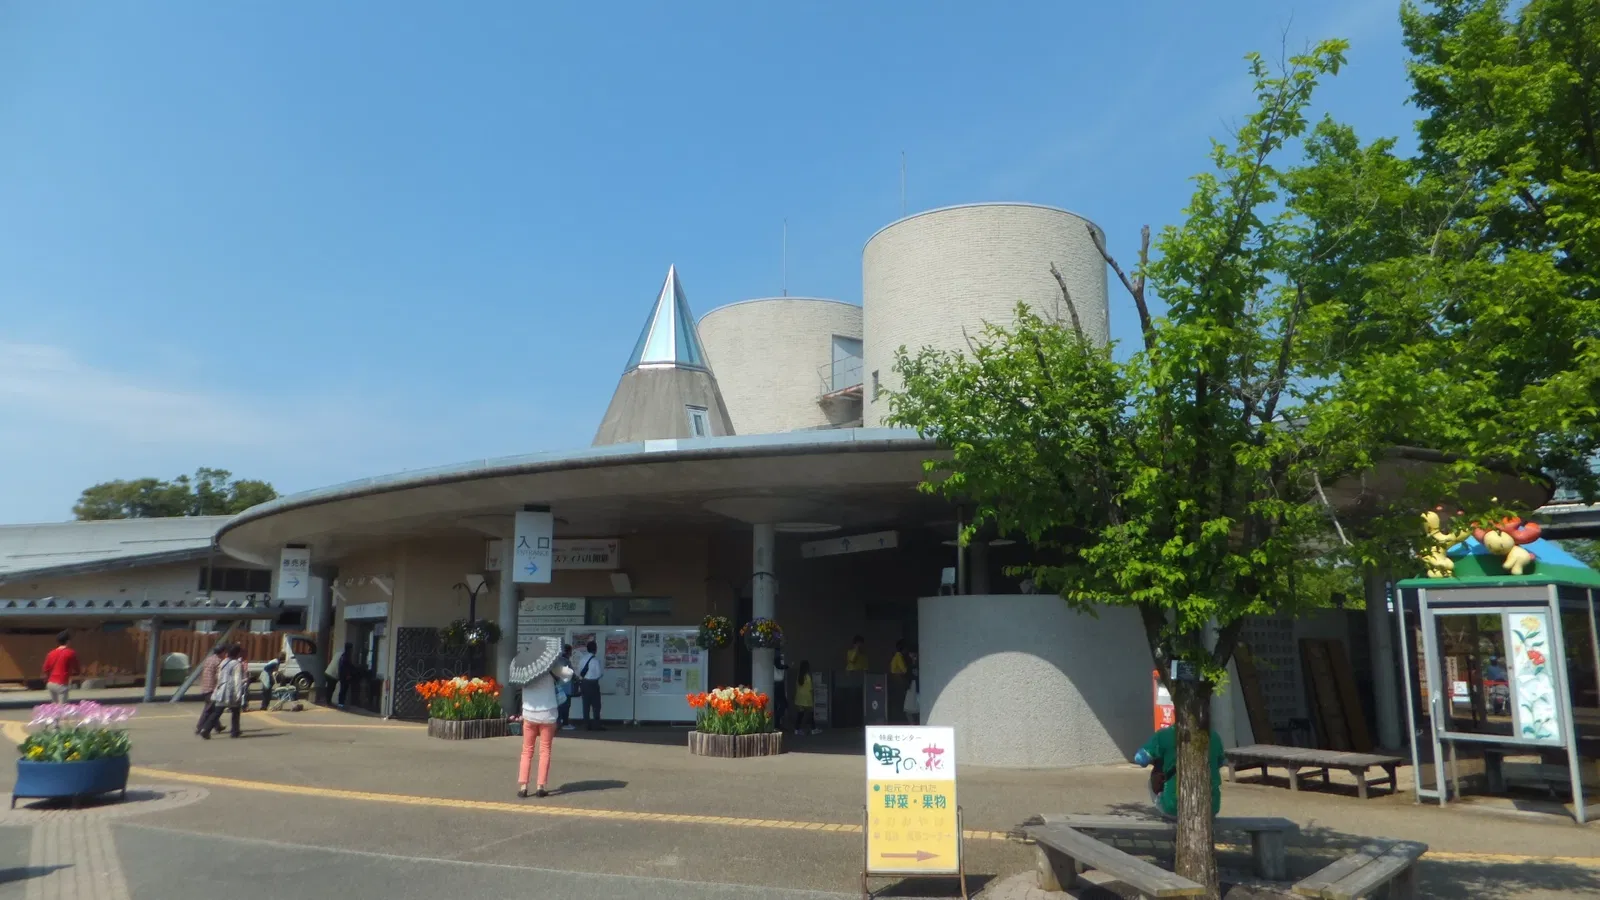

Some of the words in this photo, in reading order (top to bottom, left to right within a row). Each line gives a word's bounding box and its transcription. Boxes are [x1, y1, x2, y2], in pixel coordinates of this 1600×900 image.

[518, 536, 550, 549] 入口
[517, 549, 550, 557] ENTRANCE
[879, 733, 922, 742] 特産センター
[873, 742, 945, 775] 野の花
[884, 784, 937, 793] 地元でとれた
[884, 794, 947, 809] 野菜・果物
